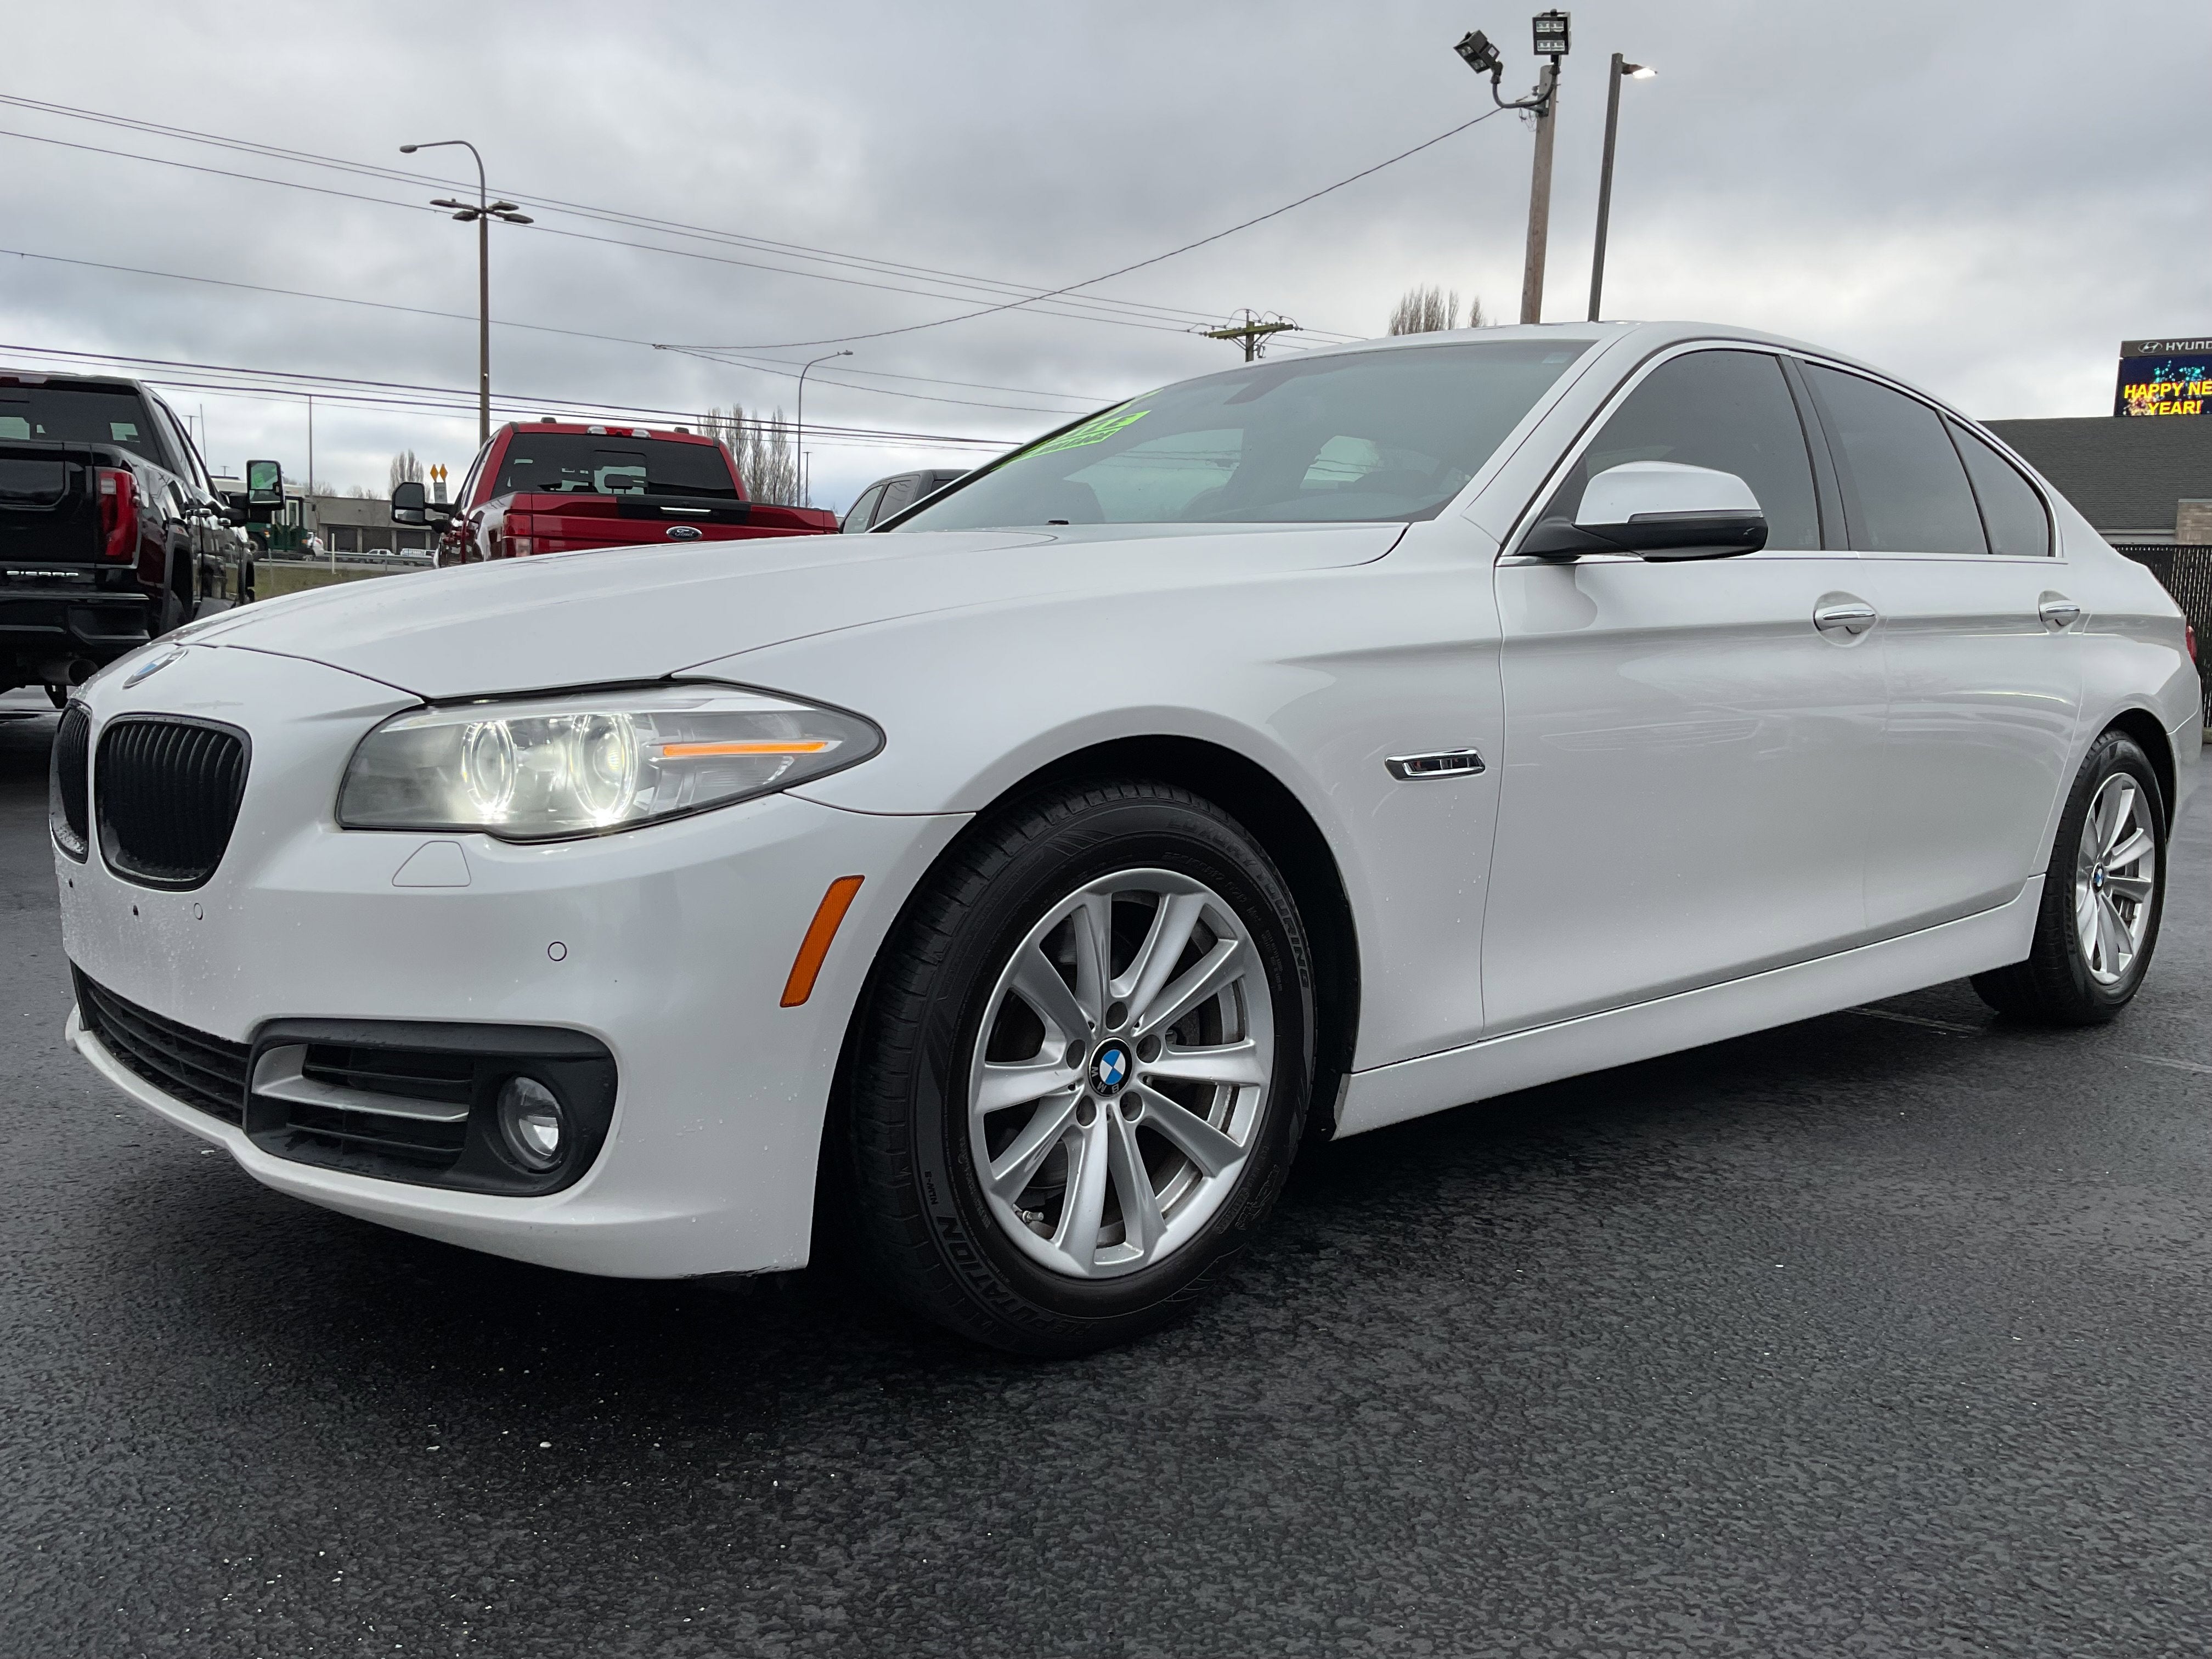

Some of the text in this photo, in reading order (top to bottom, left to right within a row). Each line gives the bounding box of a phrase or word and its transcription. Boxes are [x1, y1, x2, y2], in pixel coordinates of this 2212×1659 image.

[2124, 383, 2185, 399] HAPPY
[2147, 401, 2202, 415] YEAR!
[675, 528, 695, 537] Ford
[1256, 868, 1310, 989] TOURING
[1091, 1066, 1119, 1093] BMW
[935, 1216, 1099, 1335] REPUTATION
